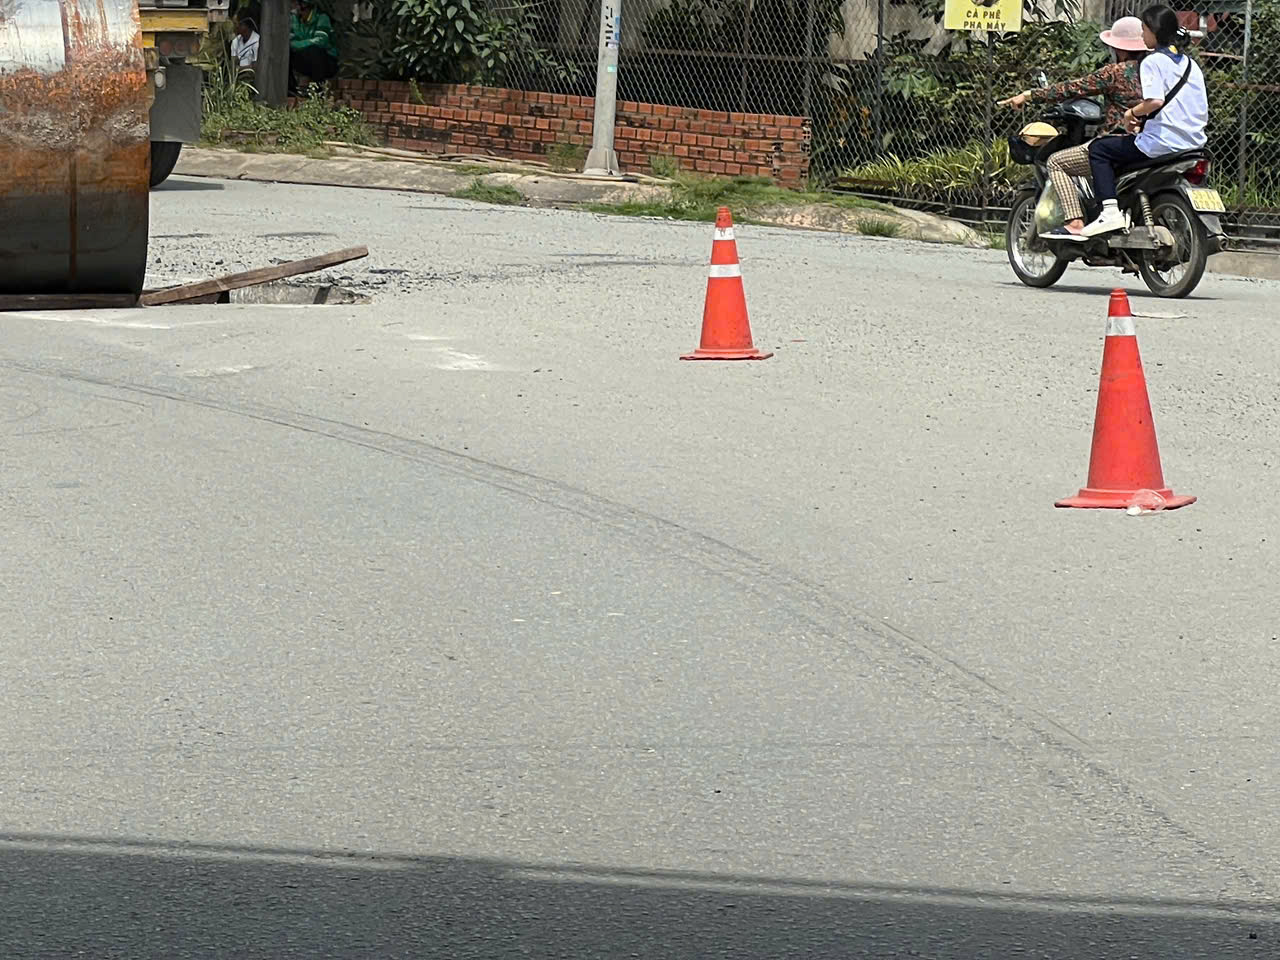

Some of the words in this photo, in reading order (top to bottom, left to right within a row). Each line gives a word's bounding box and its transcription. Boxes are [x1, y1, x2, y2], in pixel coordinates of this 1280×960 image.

[983, 9, 1001, 19] PHÊ
[964, 21, 982, 29] PHA
[987, 20, 1006, 30] MÁY
